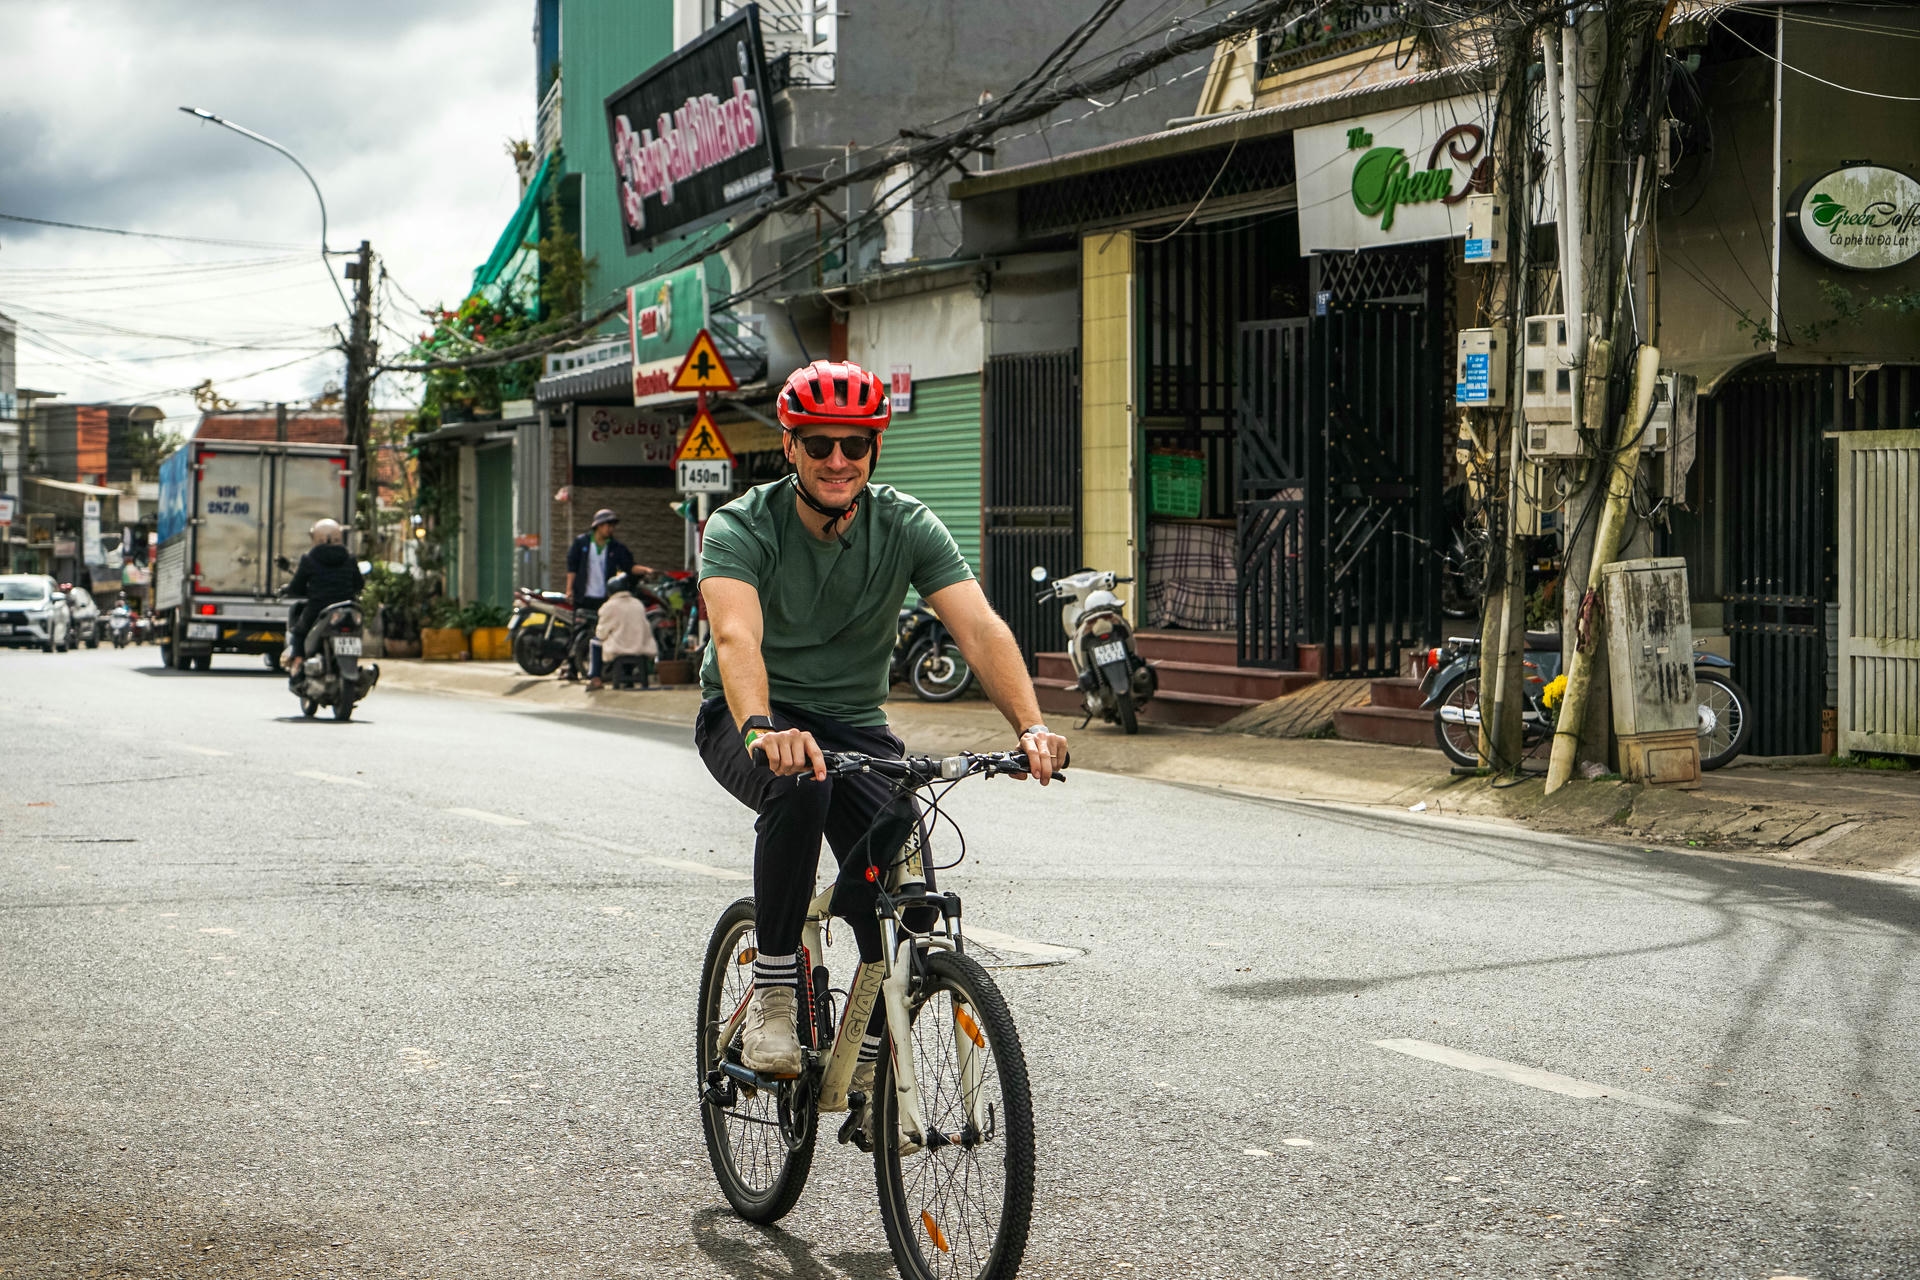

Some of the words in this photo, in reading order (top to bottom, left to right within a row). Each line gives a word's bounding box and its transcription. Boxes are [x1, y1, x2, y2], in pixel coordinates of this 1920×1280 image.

[1347, 127, 1373, 149] The
[1352, 147, 1452, 230] Green
[1812, 203, 1875, 234] Green
[689, 468, 719, 484] 450m
